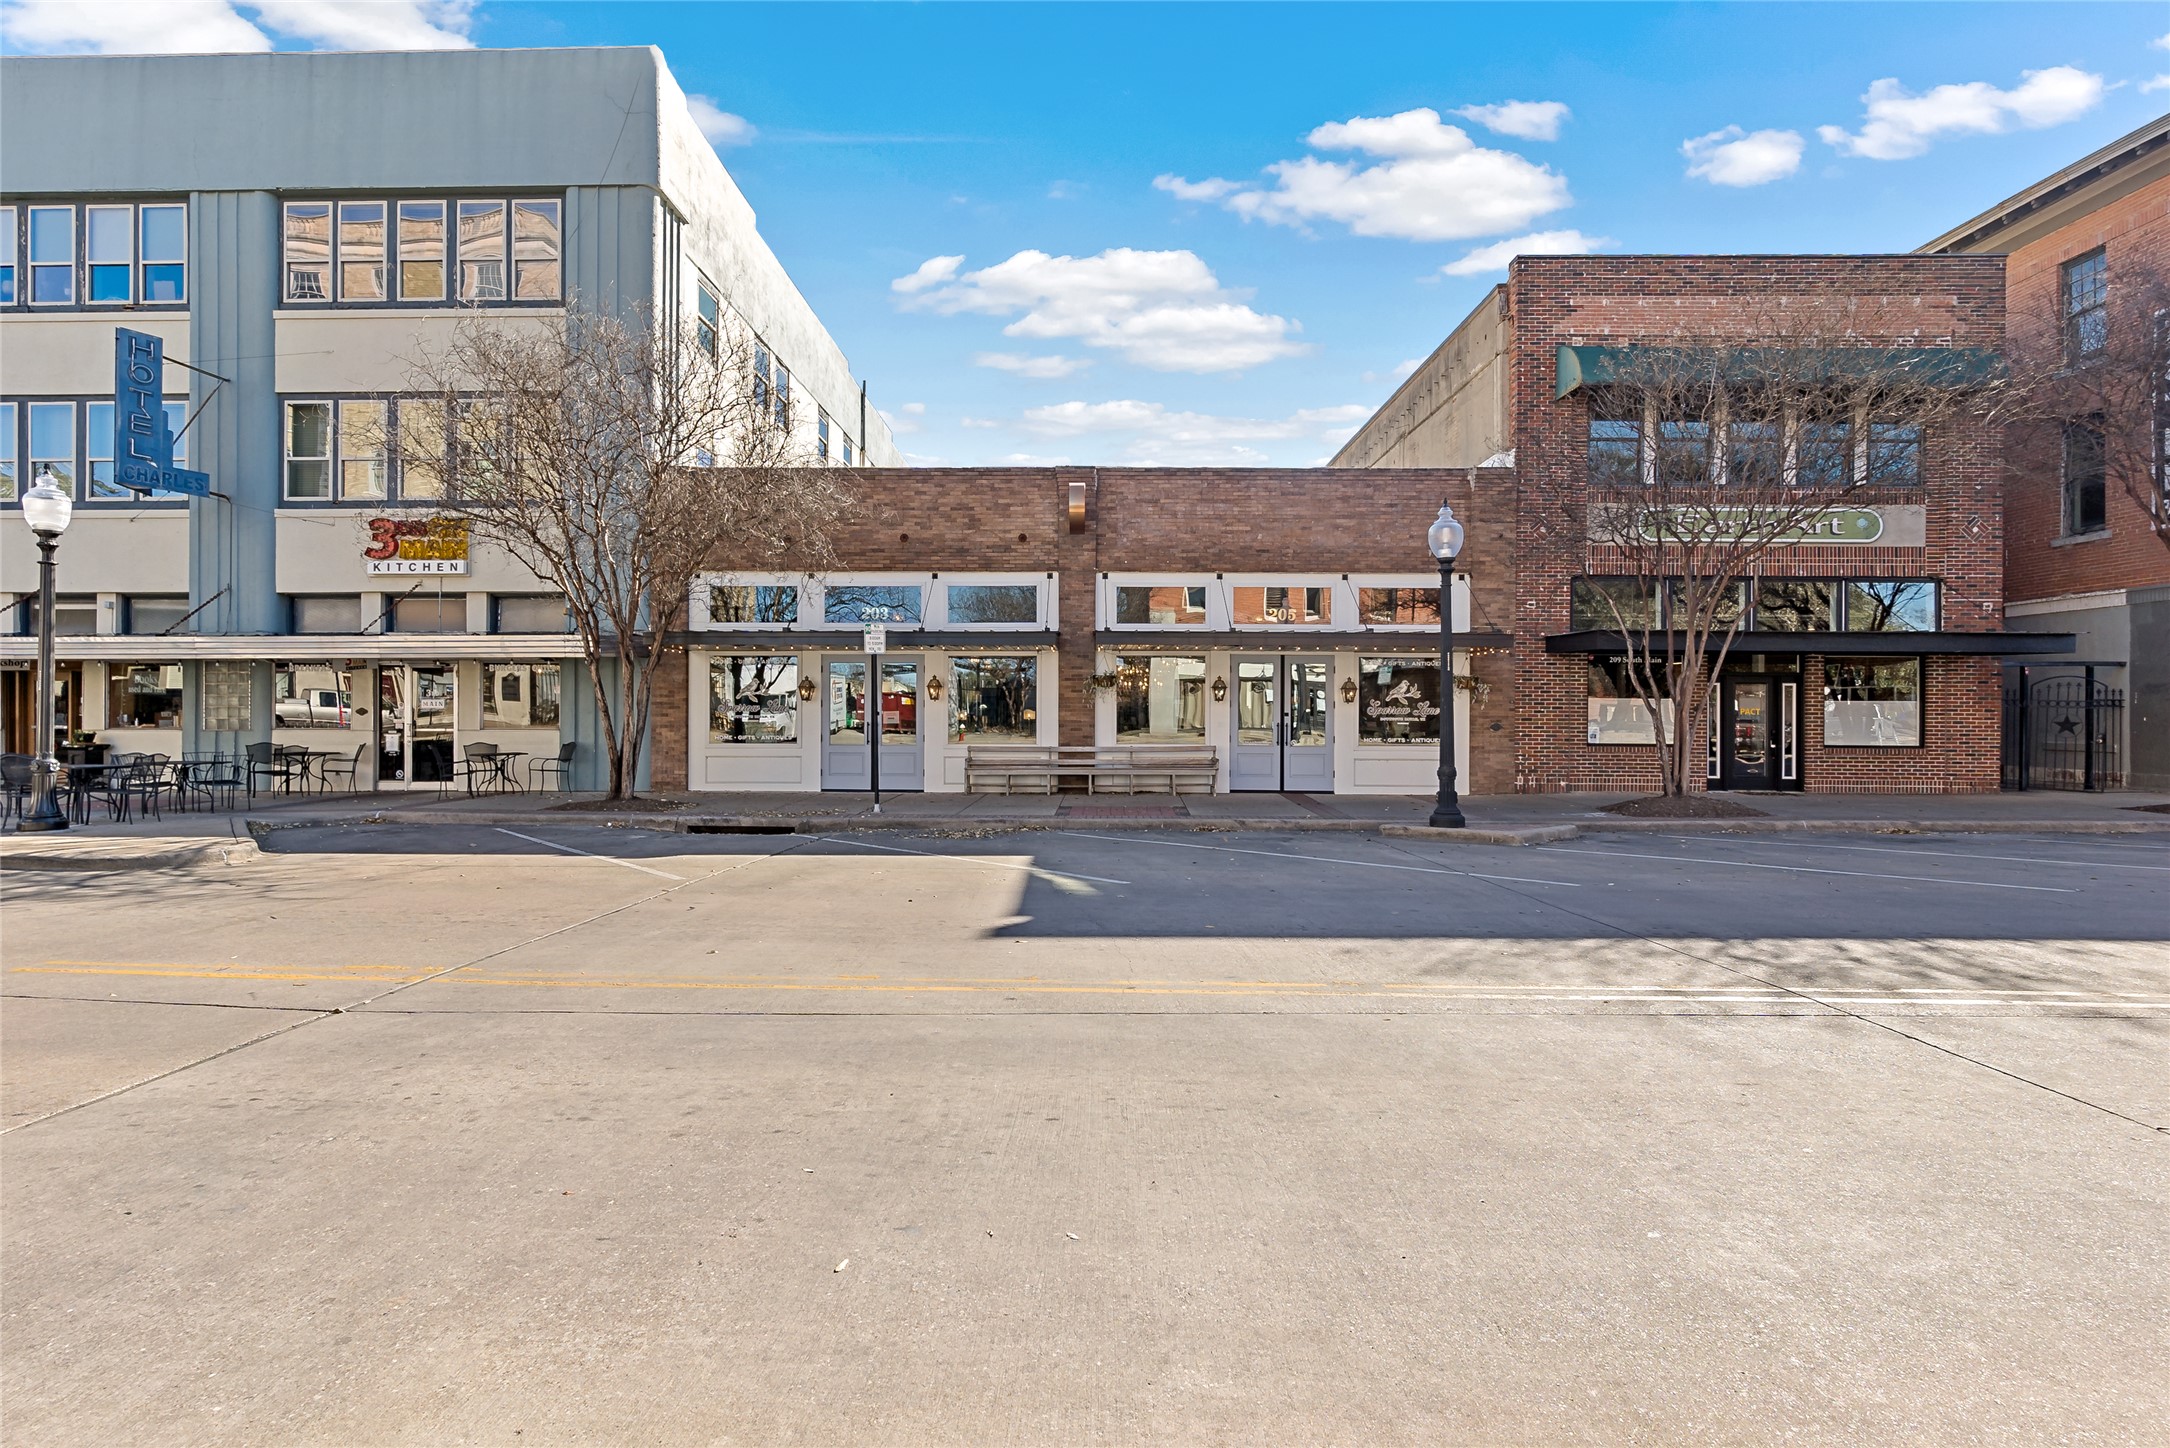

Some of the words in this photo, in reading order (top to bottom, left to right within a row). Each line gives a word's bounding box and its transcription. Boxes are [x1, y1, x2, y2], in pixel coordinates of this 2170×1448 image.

[128, 336, 157, 467] HOTEL
[123, 466, 206, 491] CHARLES
[373, 562, 458, 572] KITCHEN
[861, 607, 889, 620] 203
[1269, 608, 1297, 621] 205
[288, 664, 332, 672] BREAKFAS
[1366, 699, 1411, 718] Sparrow
[1412, 700, 1441, 718] Lane
[1740, 708, 1760, 716] PACT
